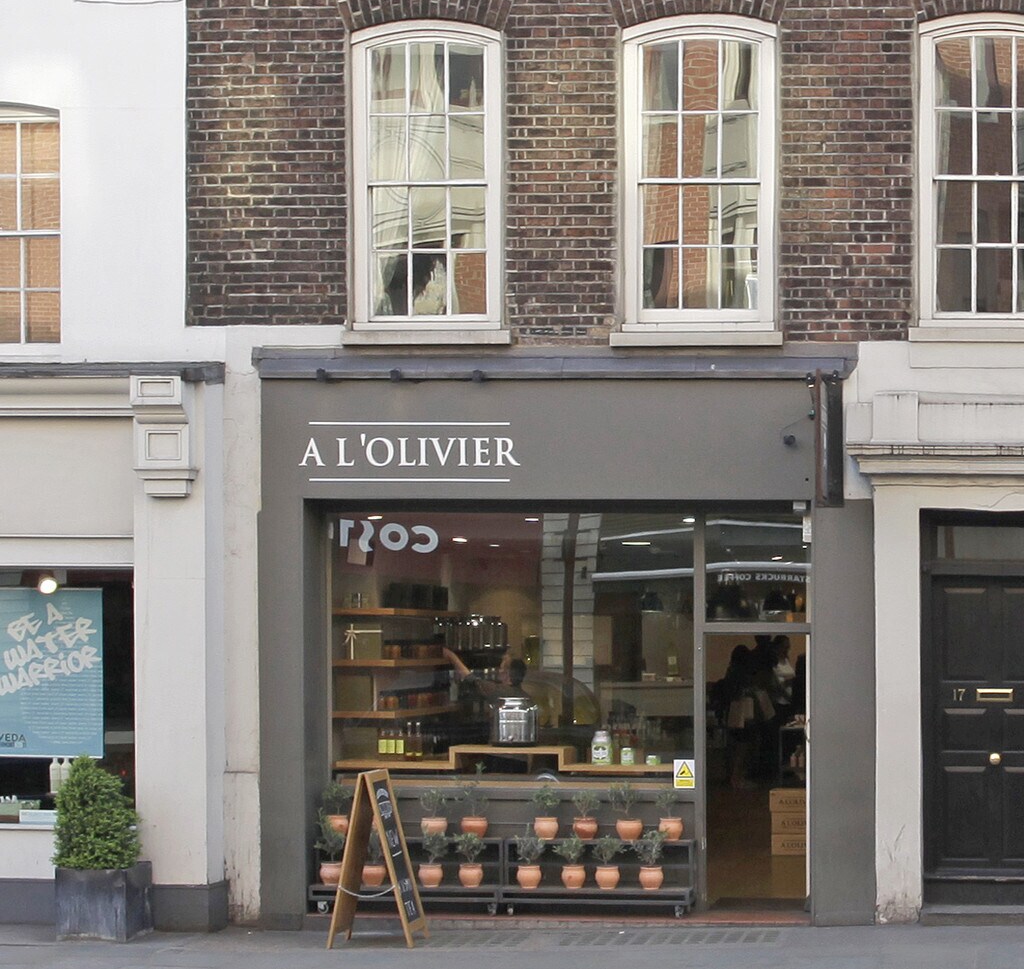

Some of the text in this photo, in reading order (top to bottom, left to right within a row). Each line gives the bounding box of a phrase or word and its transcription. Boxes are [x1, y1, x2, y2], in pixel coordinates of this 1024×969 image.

[298, 438, 326, 466] A
[7, 612, 43, 642] BE
[47, 602, 63, 625] A
[3, 617, 97, 670] WATER
[953, 688, 966, 701] 17
